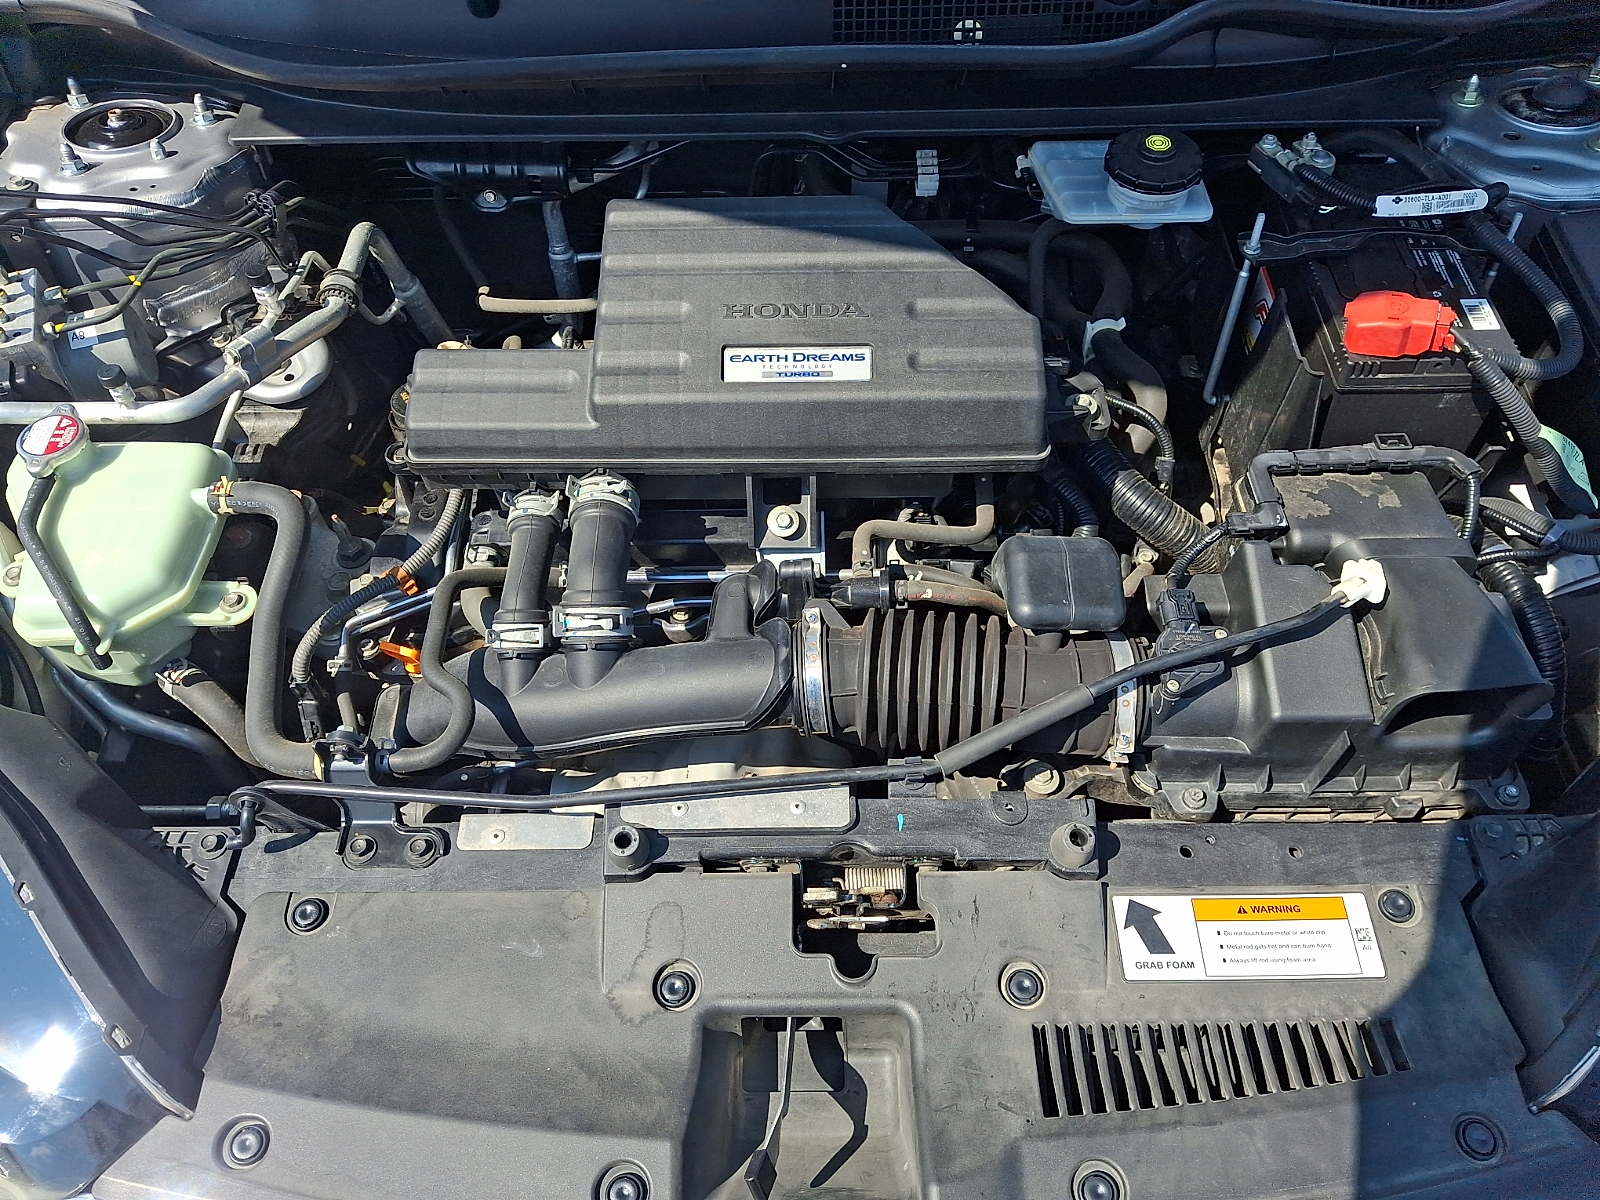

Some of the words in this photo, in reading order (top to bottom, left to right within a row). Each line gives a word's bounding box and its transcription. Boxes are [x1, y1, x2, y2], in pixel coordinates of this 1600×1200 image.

[722, 302, 871, 320] HONDA
[729, 354, 788, 363] EARTH
[792, 352, 866, 363] DREAMS
[1249, 904, 1302, 914] WARNING
[1134, 961, 1164, 970] GRAB
[1165, 961, 1196, 970] FOAM
